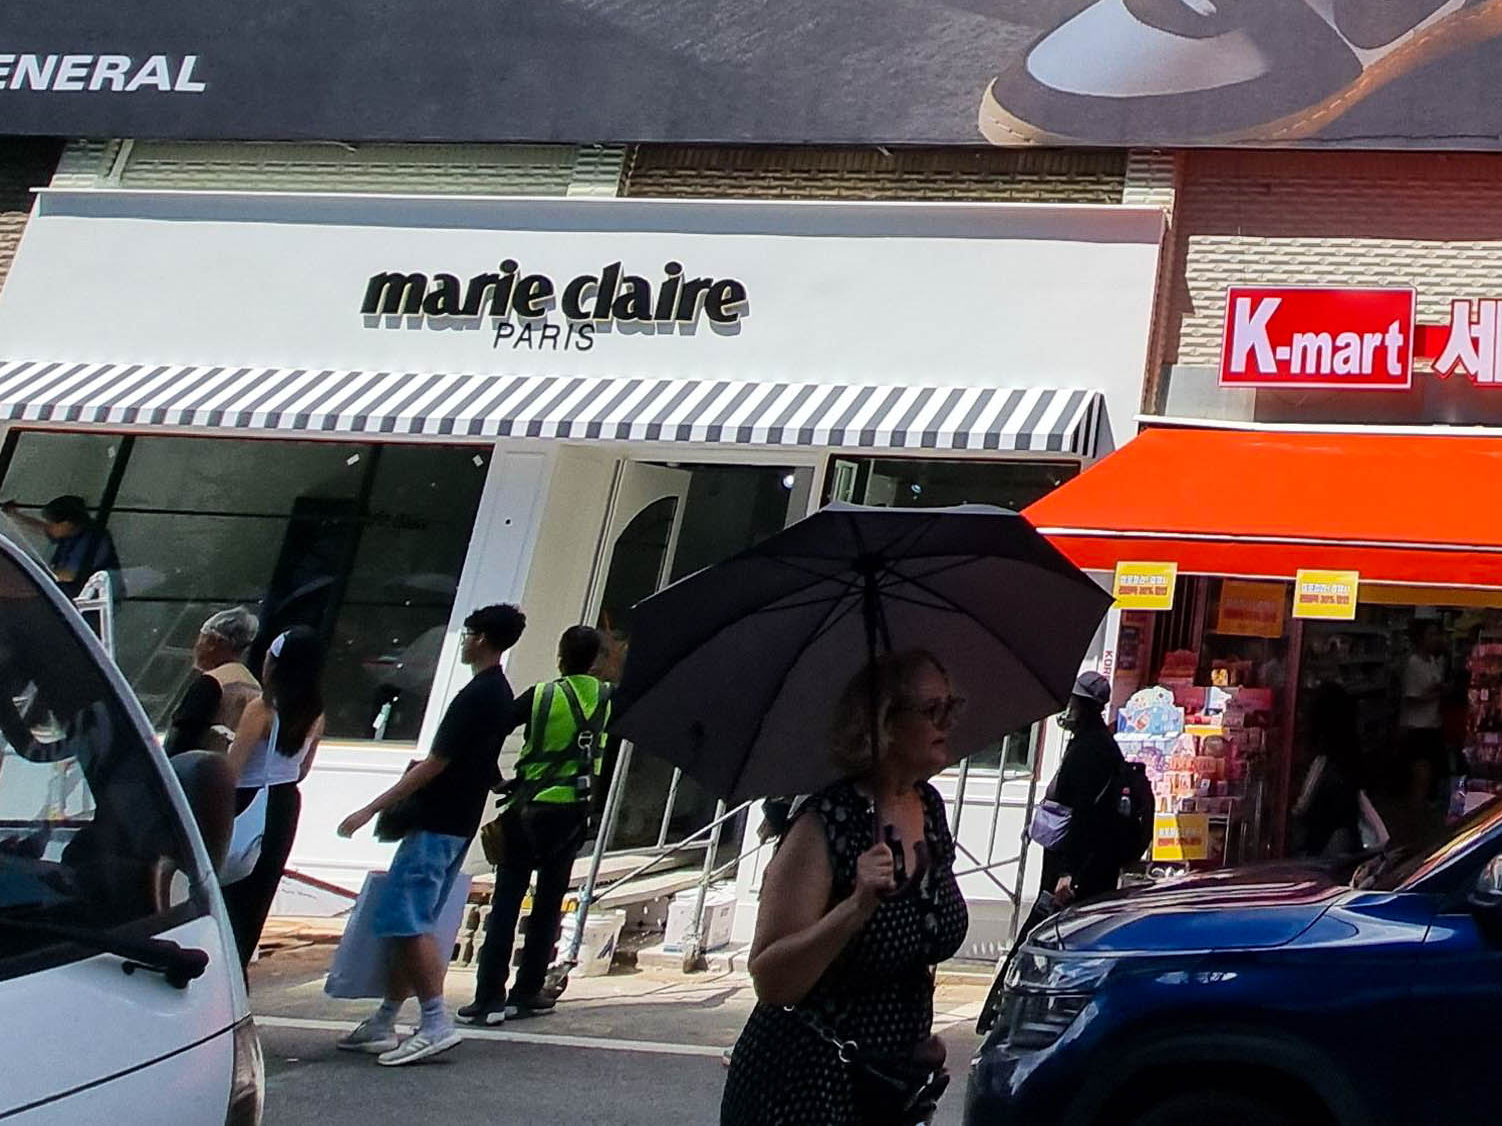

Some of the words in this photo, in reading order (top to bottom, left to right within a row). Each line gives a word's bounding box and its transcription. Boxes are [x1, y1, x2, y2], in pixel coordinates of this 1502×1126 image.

[360, 259, 555, 320] marie
[561, 261, 747, 325] claire
[493, 322, 594, 351] PARIS
[1230, 297, 1404, 374] K-mart
